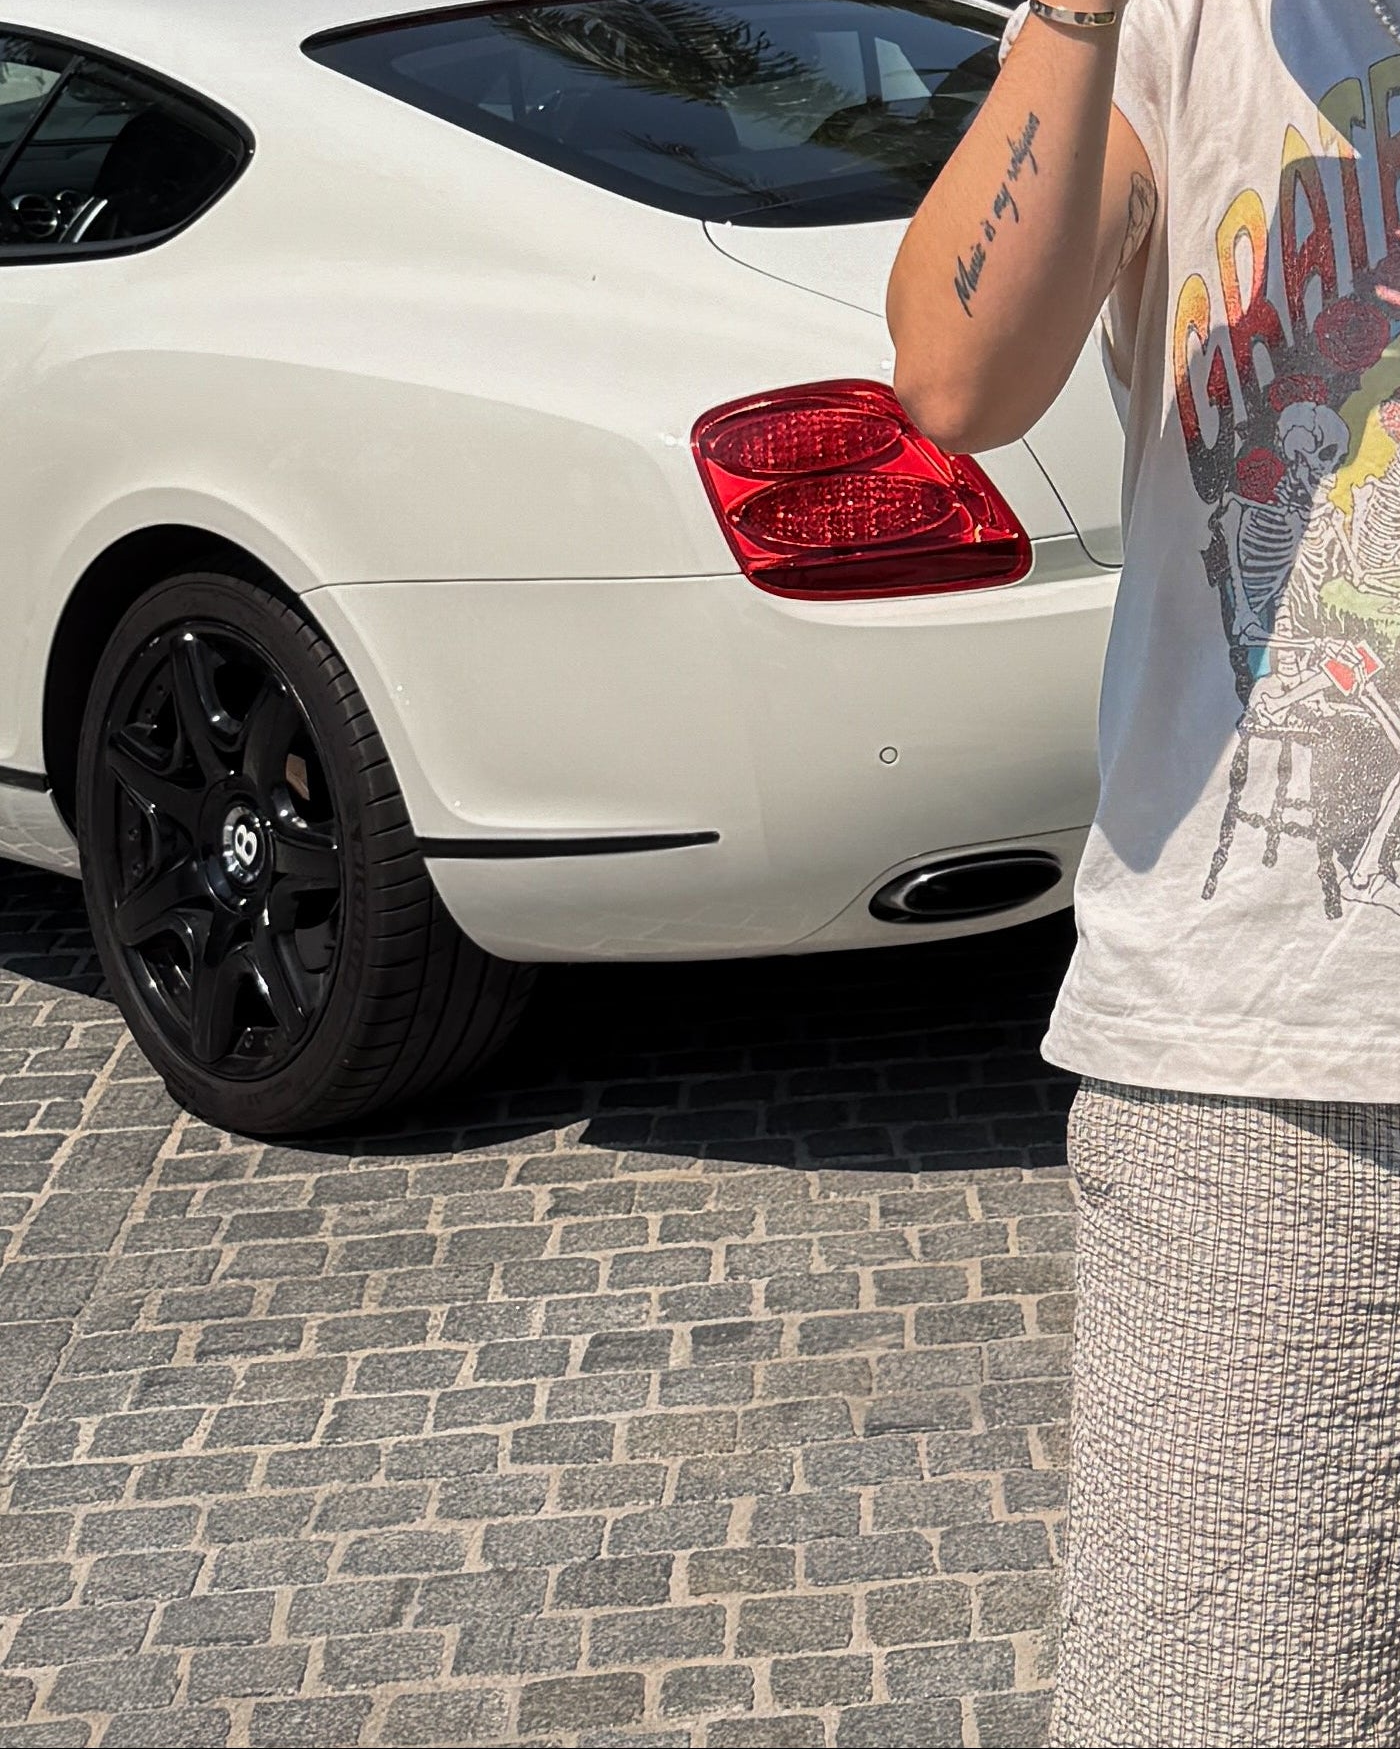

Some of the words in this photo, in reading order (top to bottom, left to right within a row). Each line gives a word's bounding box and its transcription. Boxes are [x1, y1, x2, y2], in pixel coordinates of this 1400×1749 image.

[954, 242, 986, 318] Music
[980, 220, 996, 242] is
[994, 182, 1019, 224] my
[235, 824, 258, 866] B
